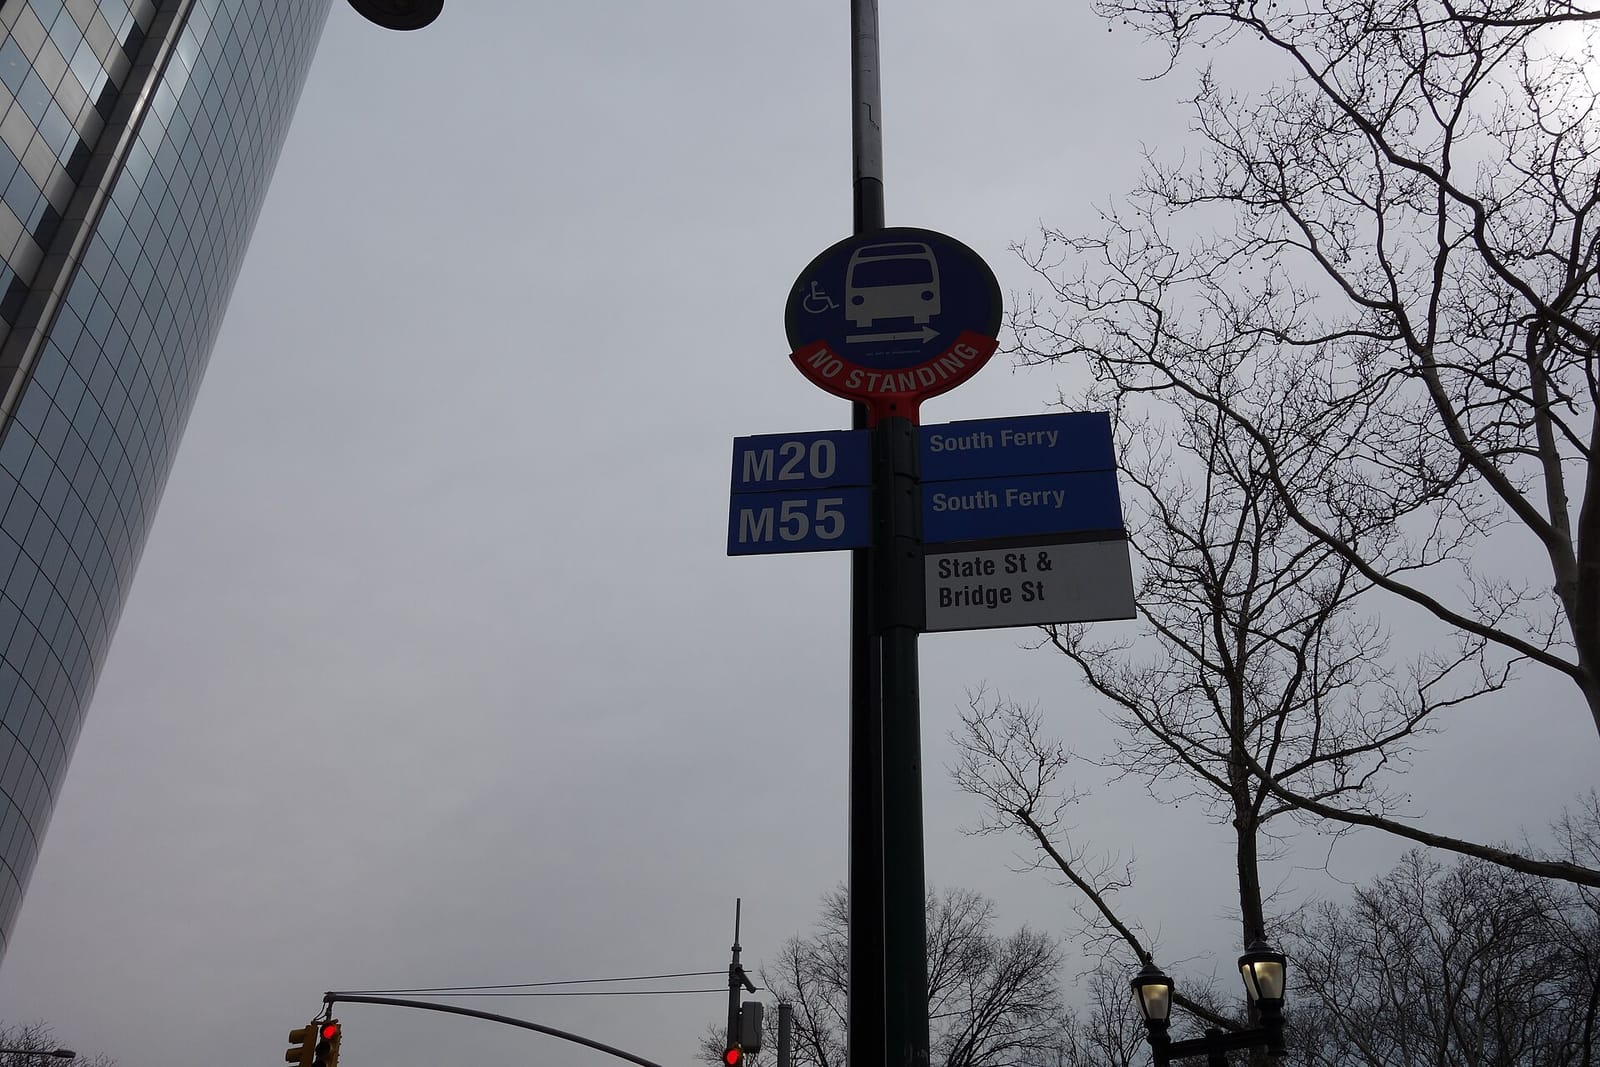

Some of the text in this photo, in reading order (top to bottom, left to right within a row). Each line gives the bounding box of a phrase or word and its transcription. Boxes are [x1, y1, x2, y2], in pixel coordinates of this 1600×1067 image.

[807, 343, 979, 393] NO STANDING
[930, 430, 1059, 452] South Ferry
[742, 439, 836, 483] M20
[932, 488, 1065, 512] South Ferry
[738, 497, 846, 544] M55
[938, 551, 1053, 579] State St &
[939, 580, 1046, 609] Bridge St
